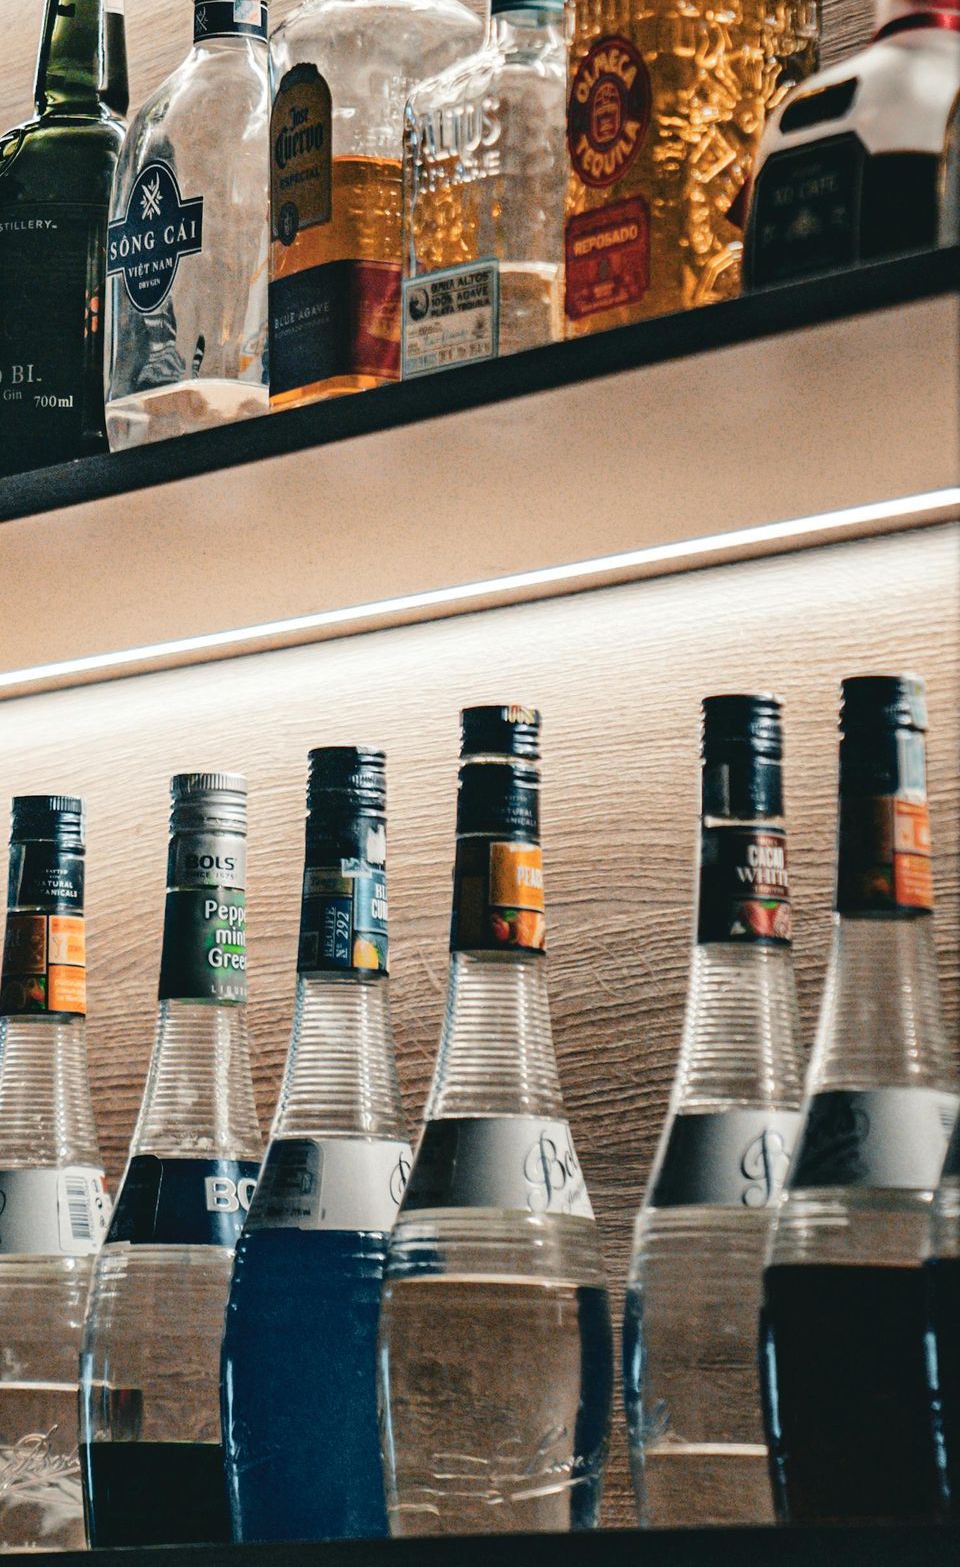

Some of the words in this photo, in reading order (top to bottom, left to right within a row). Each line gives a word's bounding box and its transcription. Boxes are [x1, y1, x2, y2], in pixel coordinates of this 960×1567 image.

[275, 122, 324, 170] Cuervo
[575, 118, 640, 179] TEQUILA
[110, 230, 156, 261] SÔNG
[163, 217, 197, 245] CÁI
[573, 224, 639, 258] REPOSADO
[152, 256, 173, 273] NAM
[457, 271, 490, 286] ALTOS
[457, 285, 490, 301] AGAVE
[274, 312, 296, 330] BLUE
[297, 301, 330, 321] AGAVE
[2, 389, 23, 402] Gin
[33, 395, 74, 409] 700ml
[186, 855, 236, 871] BOLS
[41, 879, 74, 890] ATURAL
[336, 910, 350, 940] 292
